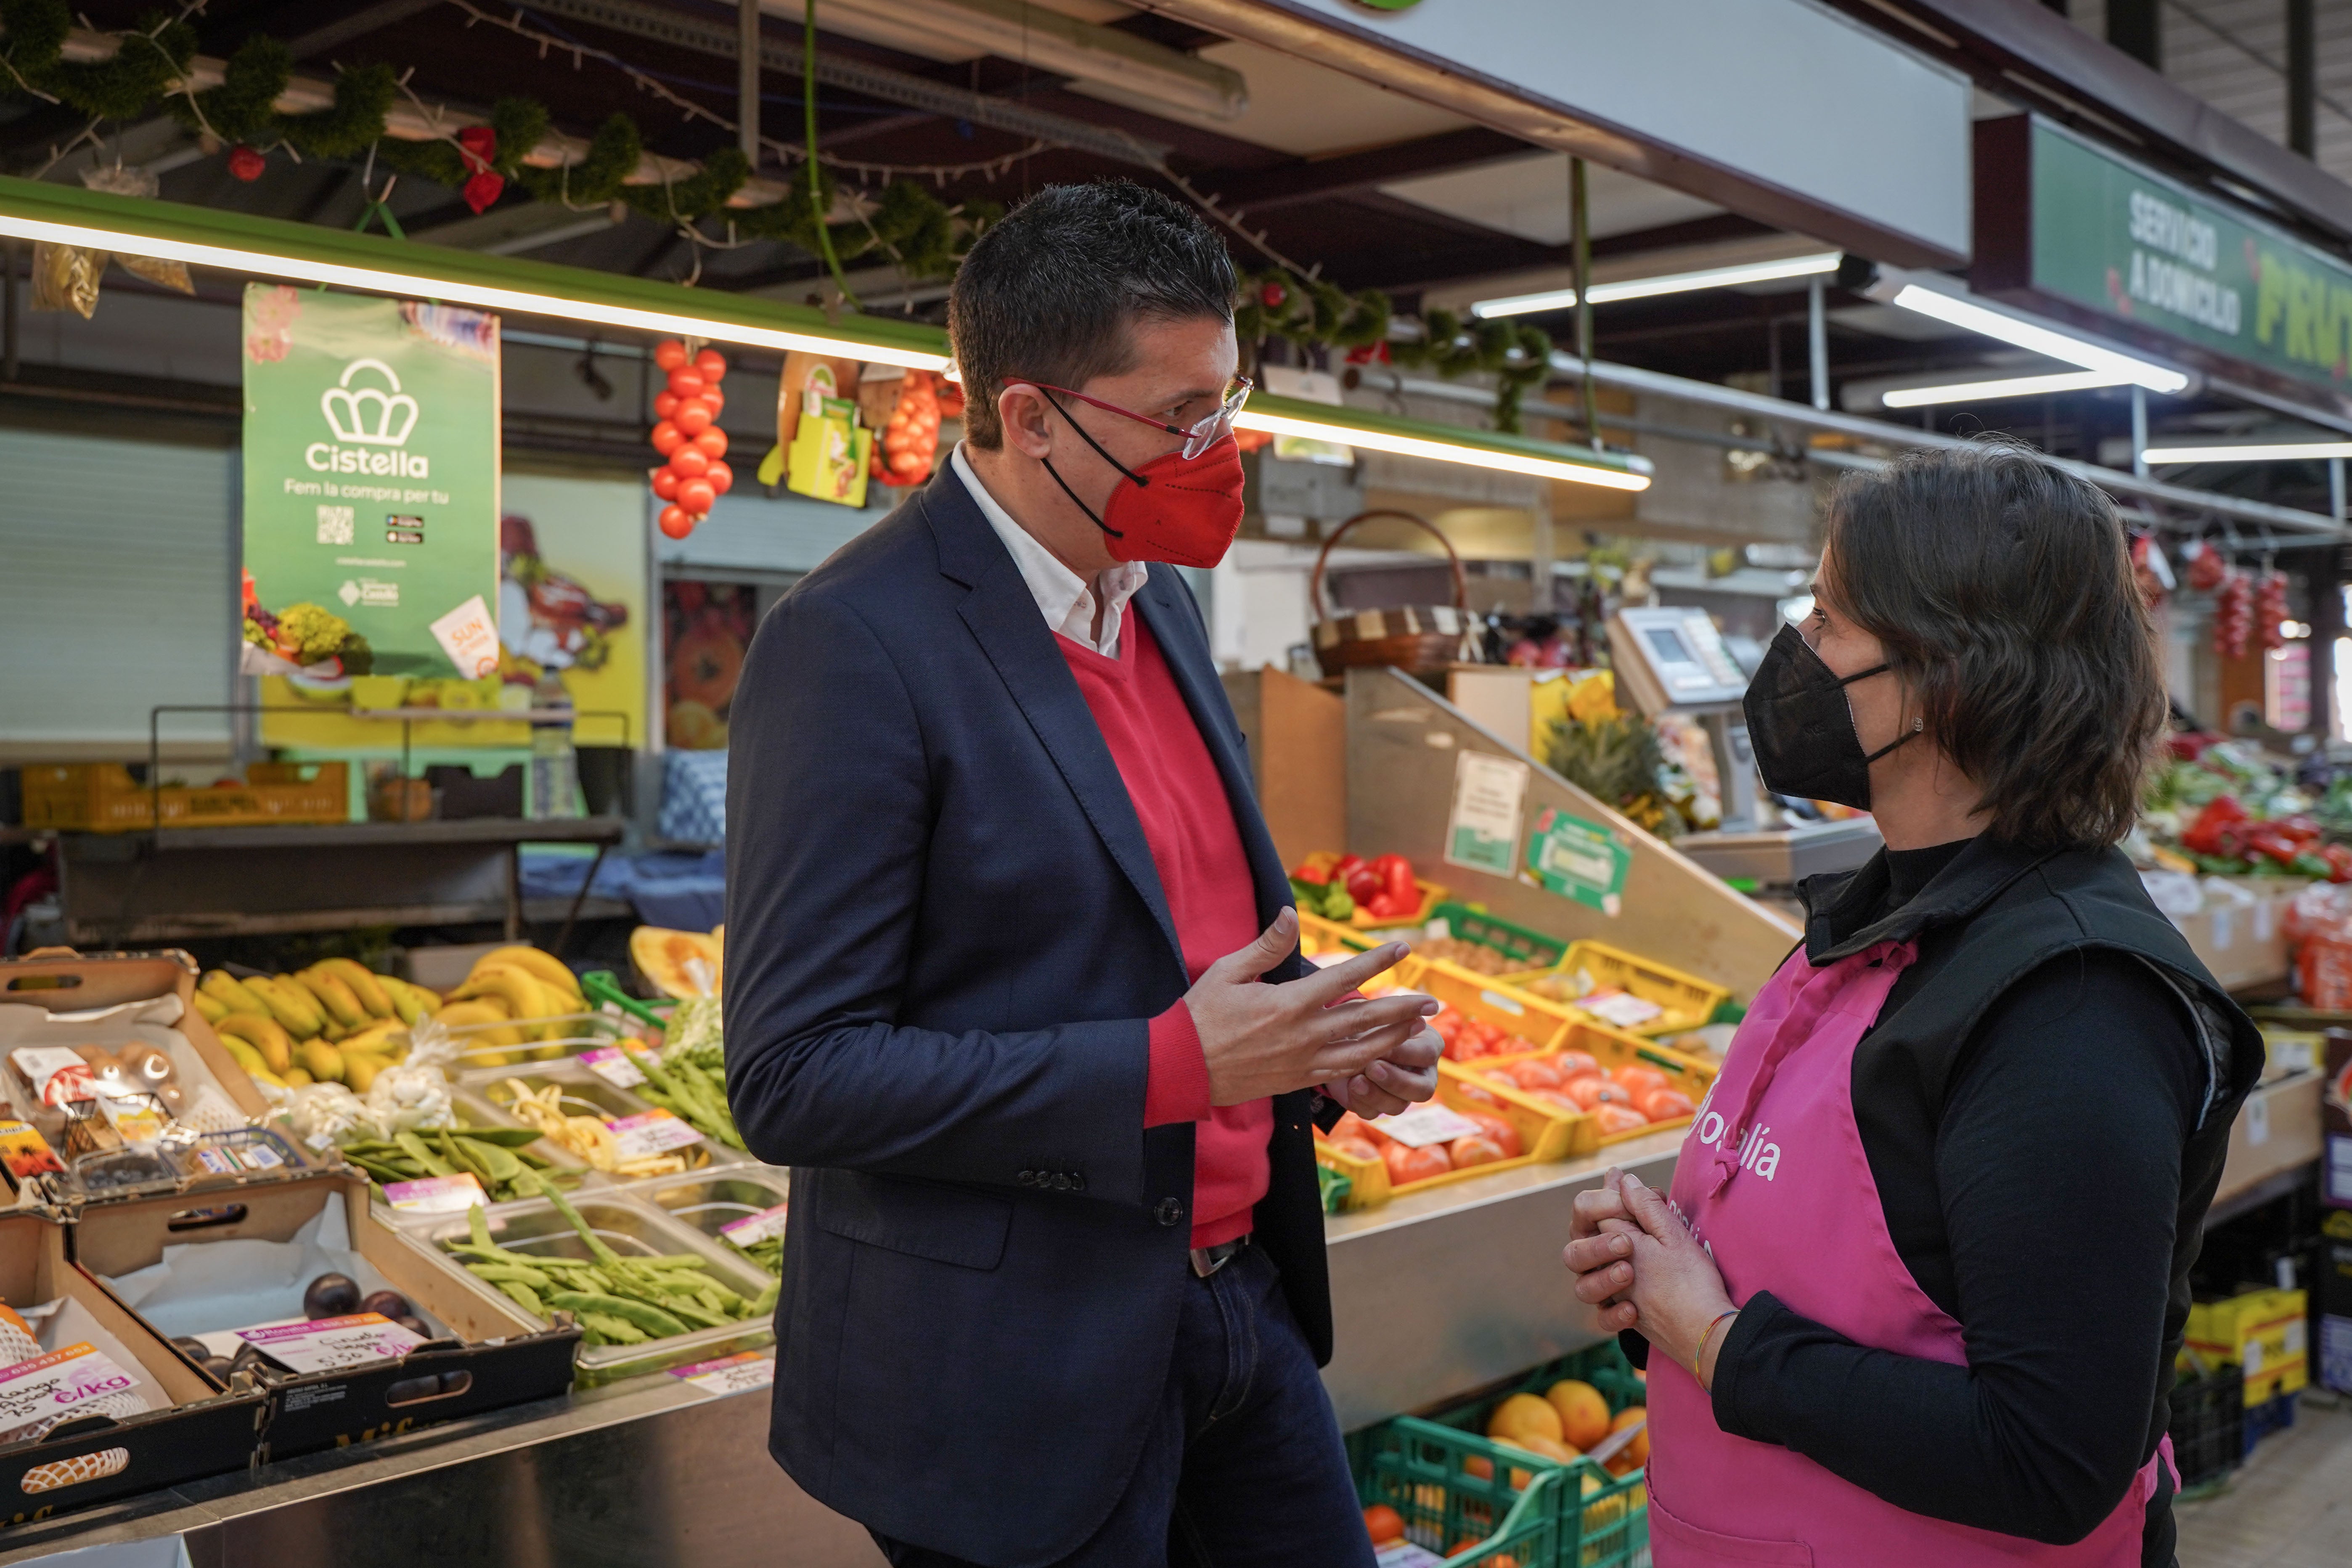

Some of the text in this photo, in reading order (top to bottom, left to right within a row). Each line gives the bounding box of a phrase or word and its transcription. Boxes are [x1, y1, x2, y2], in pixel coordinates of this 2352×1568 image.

[305, 442, 429, 479] Cistella
[284, 478, 449, 505] Fem la compra per tu
[54, 1376, 131, 1404] €/kg
